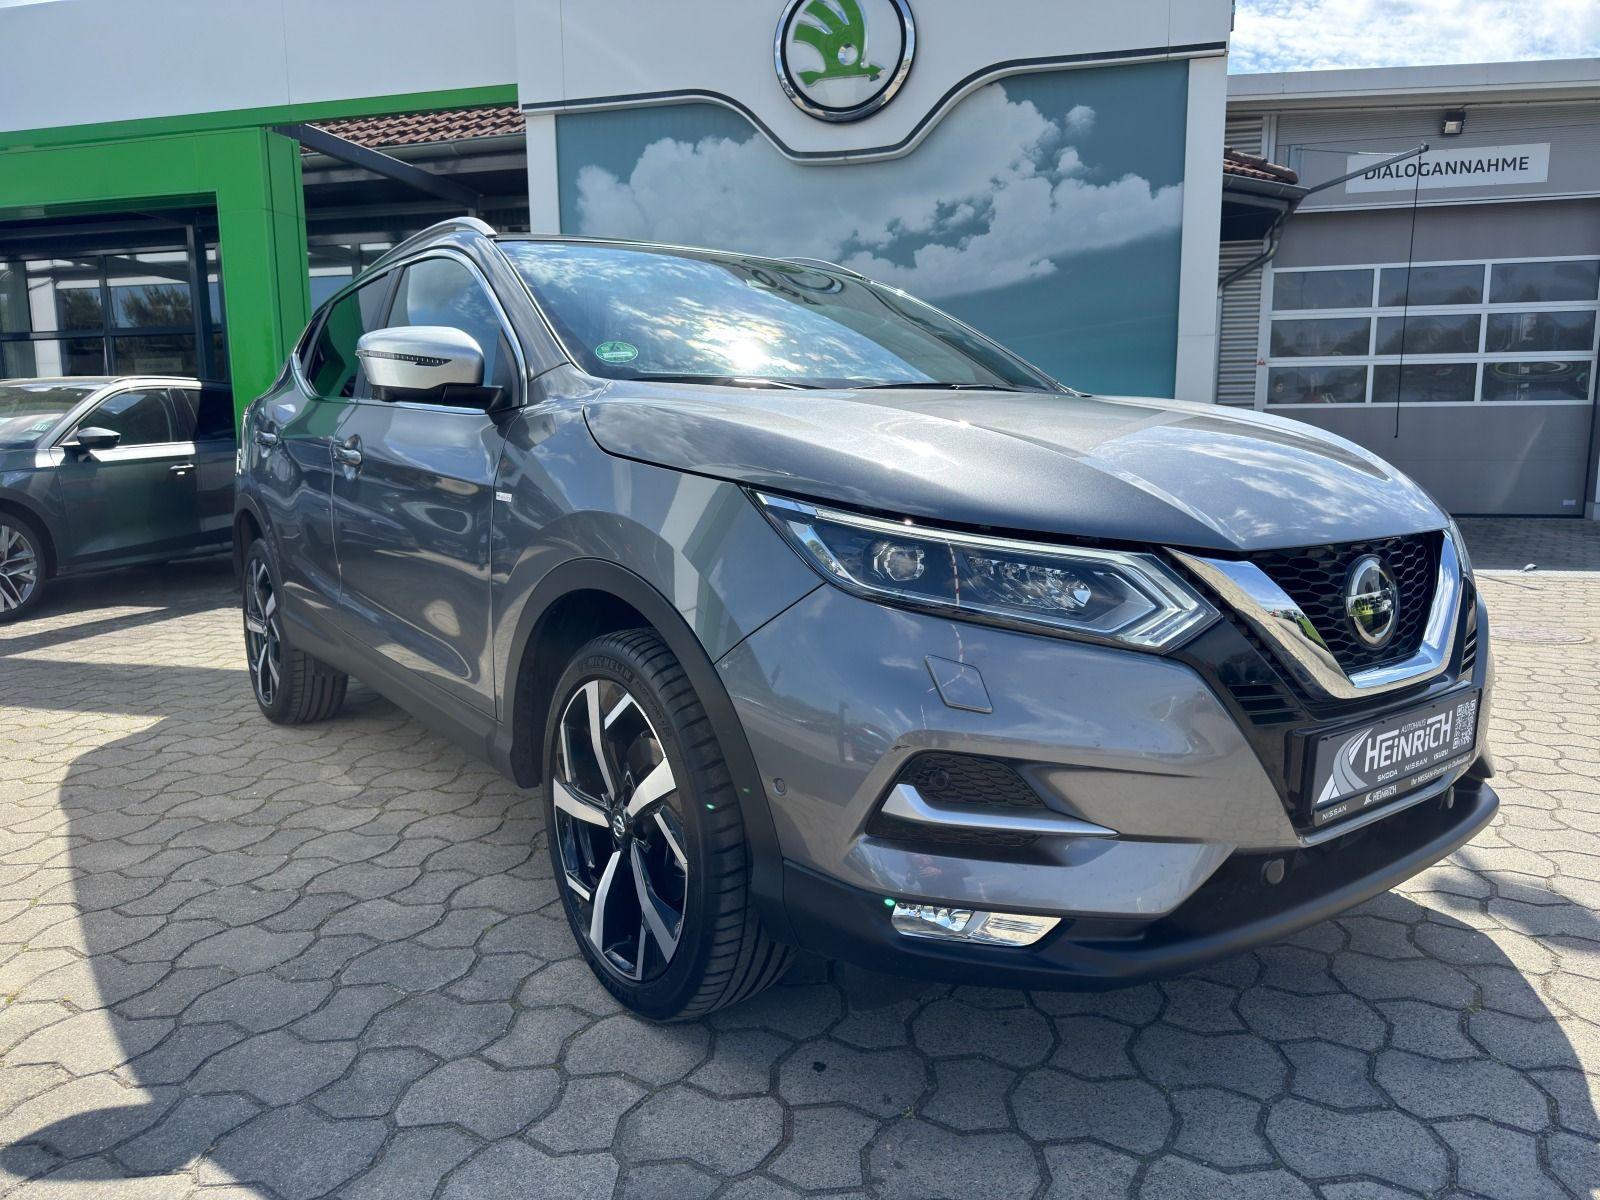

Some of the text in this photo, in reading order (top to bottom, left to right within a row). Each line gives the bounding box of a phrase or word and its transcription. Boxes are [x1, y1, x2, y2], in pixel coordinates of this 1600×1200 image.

[1364, 157, 1529, 179] DIALOGANNAHME
[1400, 719, 1426, 734] AUTOHAUS
[1404, 757, 1428, 771] NISSAN
[1433, 749, 1449, 760] ISUZU
[1322, 805, 1347, 820] NISSAN
